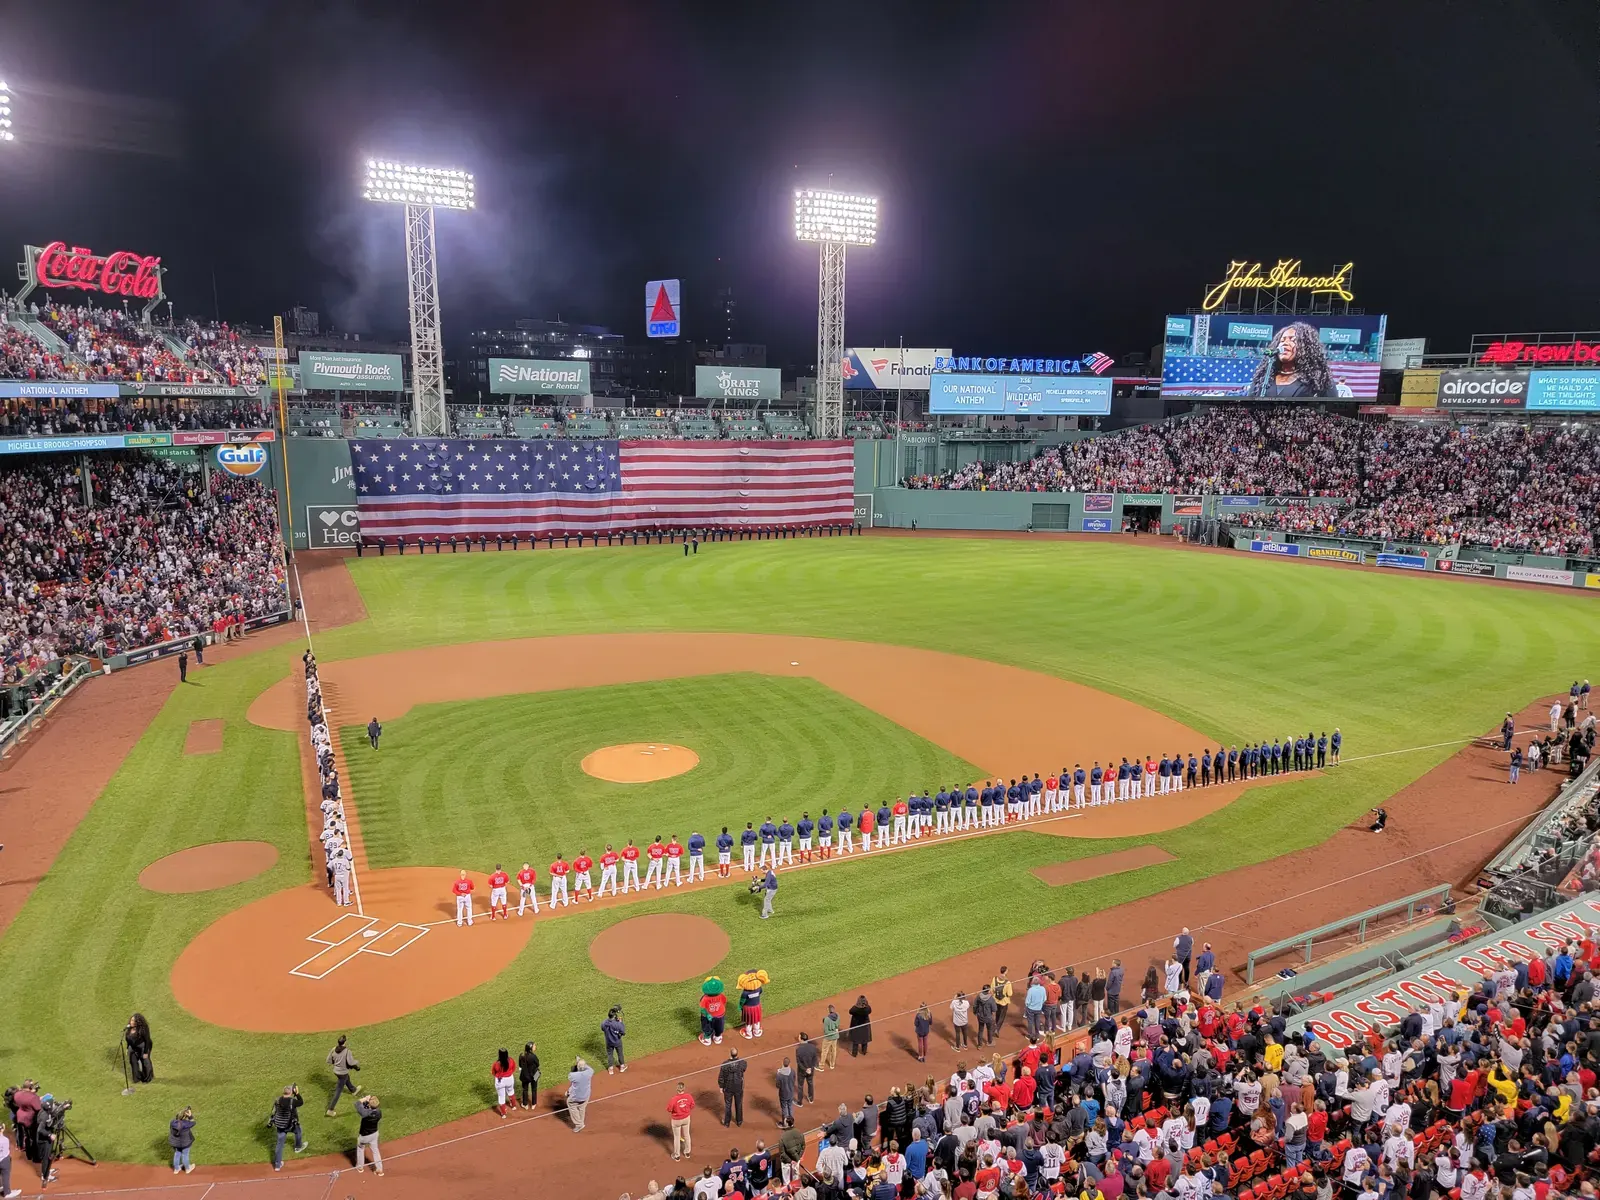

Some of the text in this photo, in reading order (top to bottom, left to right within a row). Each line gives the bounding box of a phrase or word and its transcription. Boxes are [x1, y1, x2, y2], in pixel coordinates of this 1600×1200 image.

[37, 241, 161, 298] Coca-Cola
[1203, 259, 1353, 310] John Hancock
[650, 322, 677, 335] CITGO
[314, 362, 390, 375] Plymouth Rock
[935, 356, 1081, 373] BANK OF AMERICA
[719, 379, 760, 390] DRAFT
[943, 386, 996, 394] OUR NATIONAL
[1444, 379, 1523, 394] airocide
[20, 386, 89, 395] NATIONAL ANTHEM
[723, 388, 759, 397] KINGS
[954, 396, 985, 404] ANTHEM
[8, 439, 107, 450] MICHELLE BROOKS-THOMPSON
[219, 450, 264, 462] Gulf
[1262, 542, 1288, 552] jetBlue
[1310, 549, 1340, 557] GRANITE
[1342, 551, 1358, 560] CITY
[1302, 968, 1473, 1050] BOSTON
[1044, 1159, 1056, 1167] 11
[729, 1172, 744, 1182] 34
